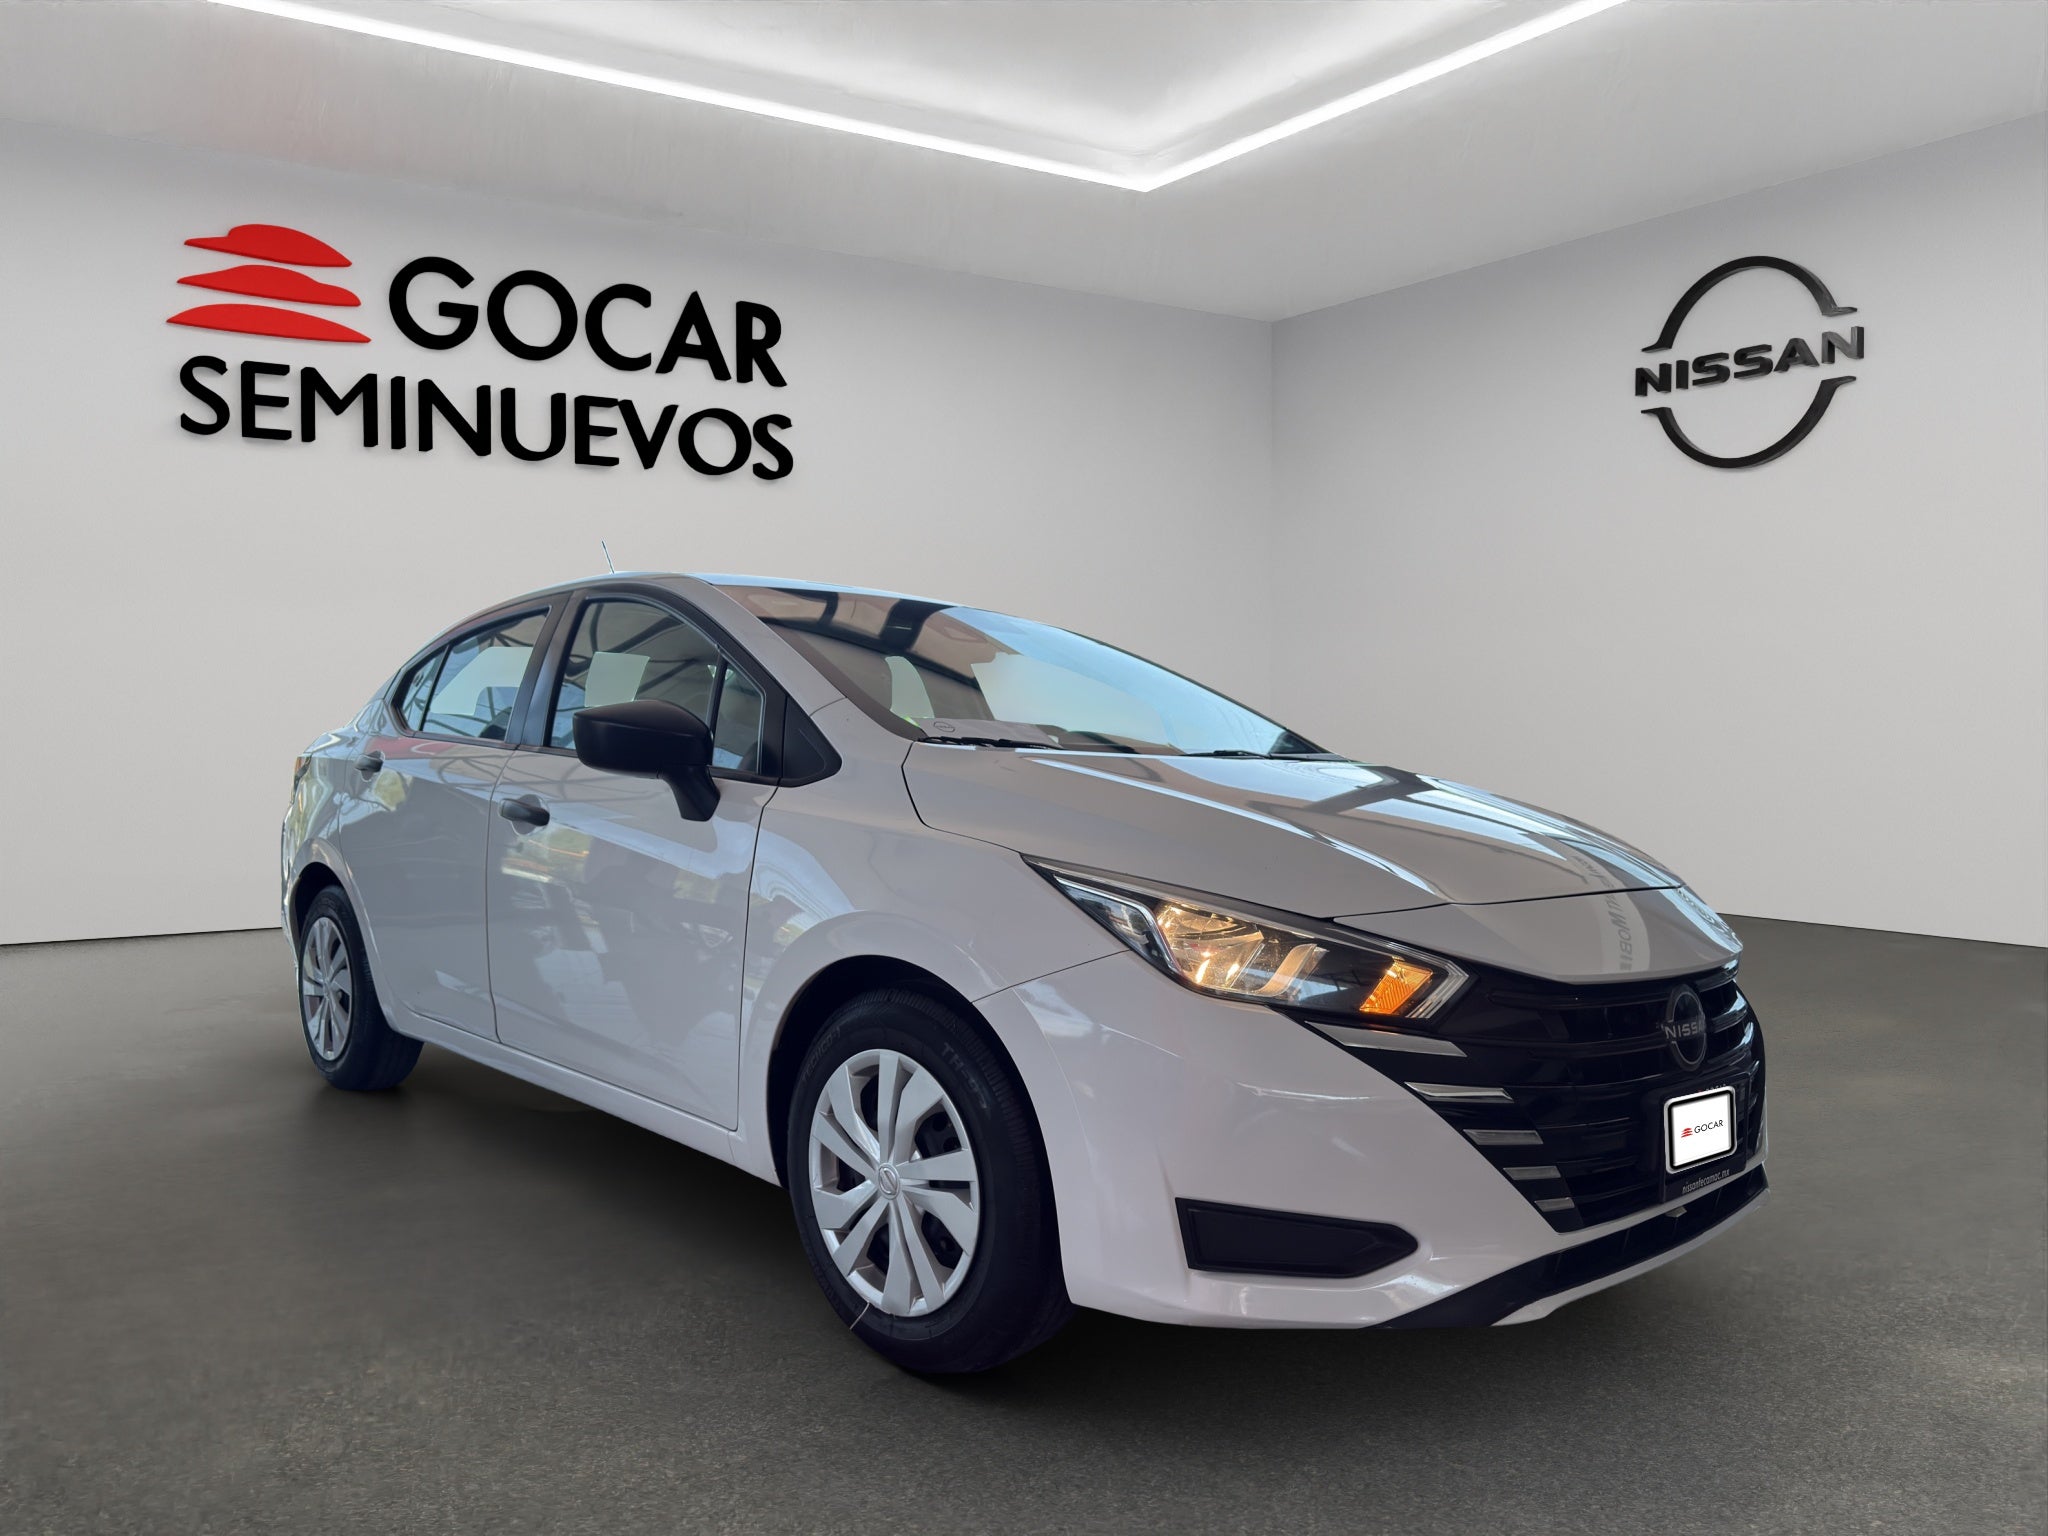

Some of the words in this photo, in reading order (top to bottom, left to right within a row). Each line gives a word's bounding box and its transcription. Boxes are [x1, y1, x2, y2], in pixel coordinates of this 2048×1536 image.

[388, 256, 788, 388] GOCAR
[1634, 325, 1865, 397] NISSAN
[178, 355, 794, 481] SEMINUEVOS
[1693, 1119, 1724, 1135] GOCAR
